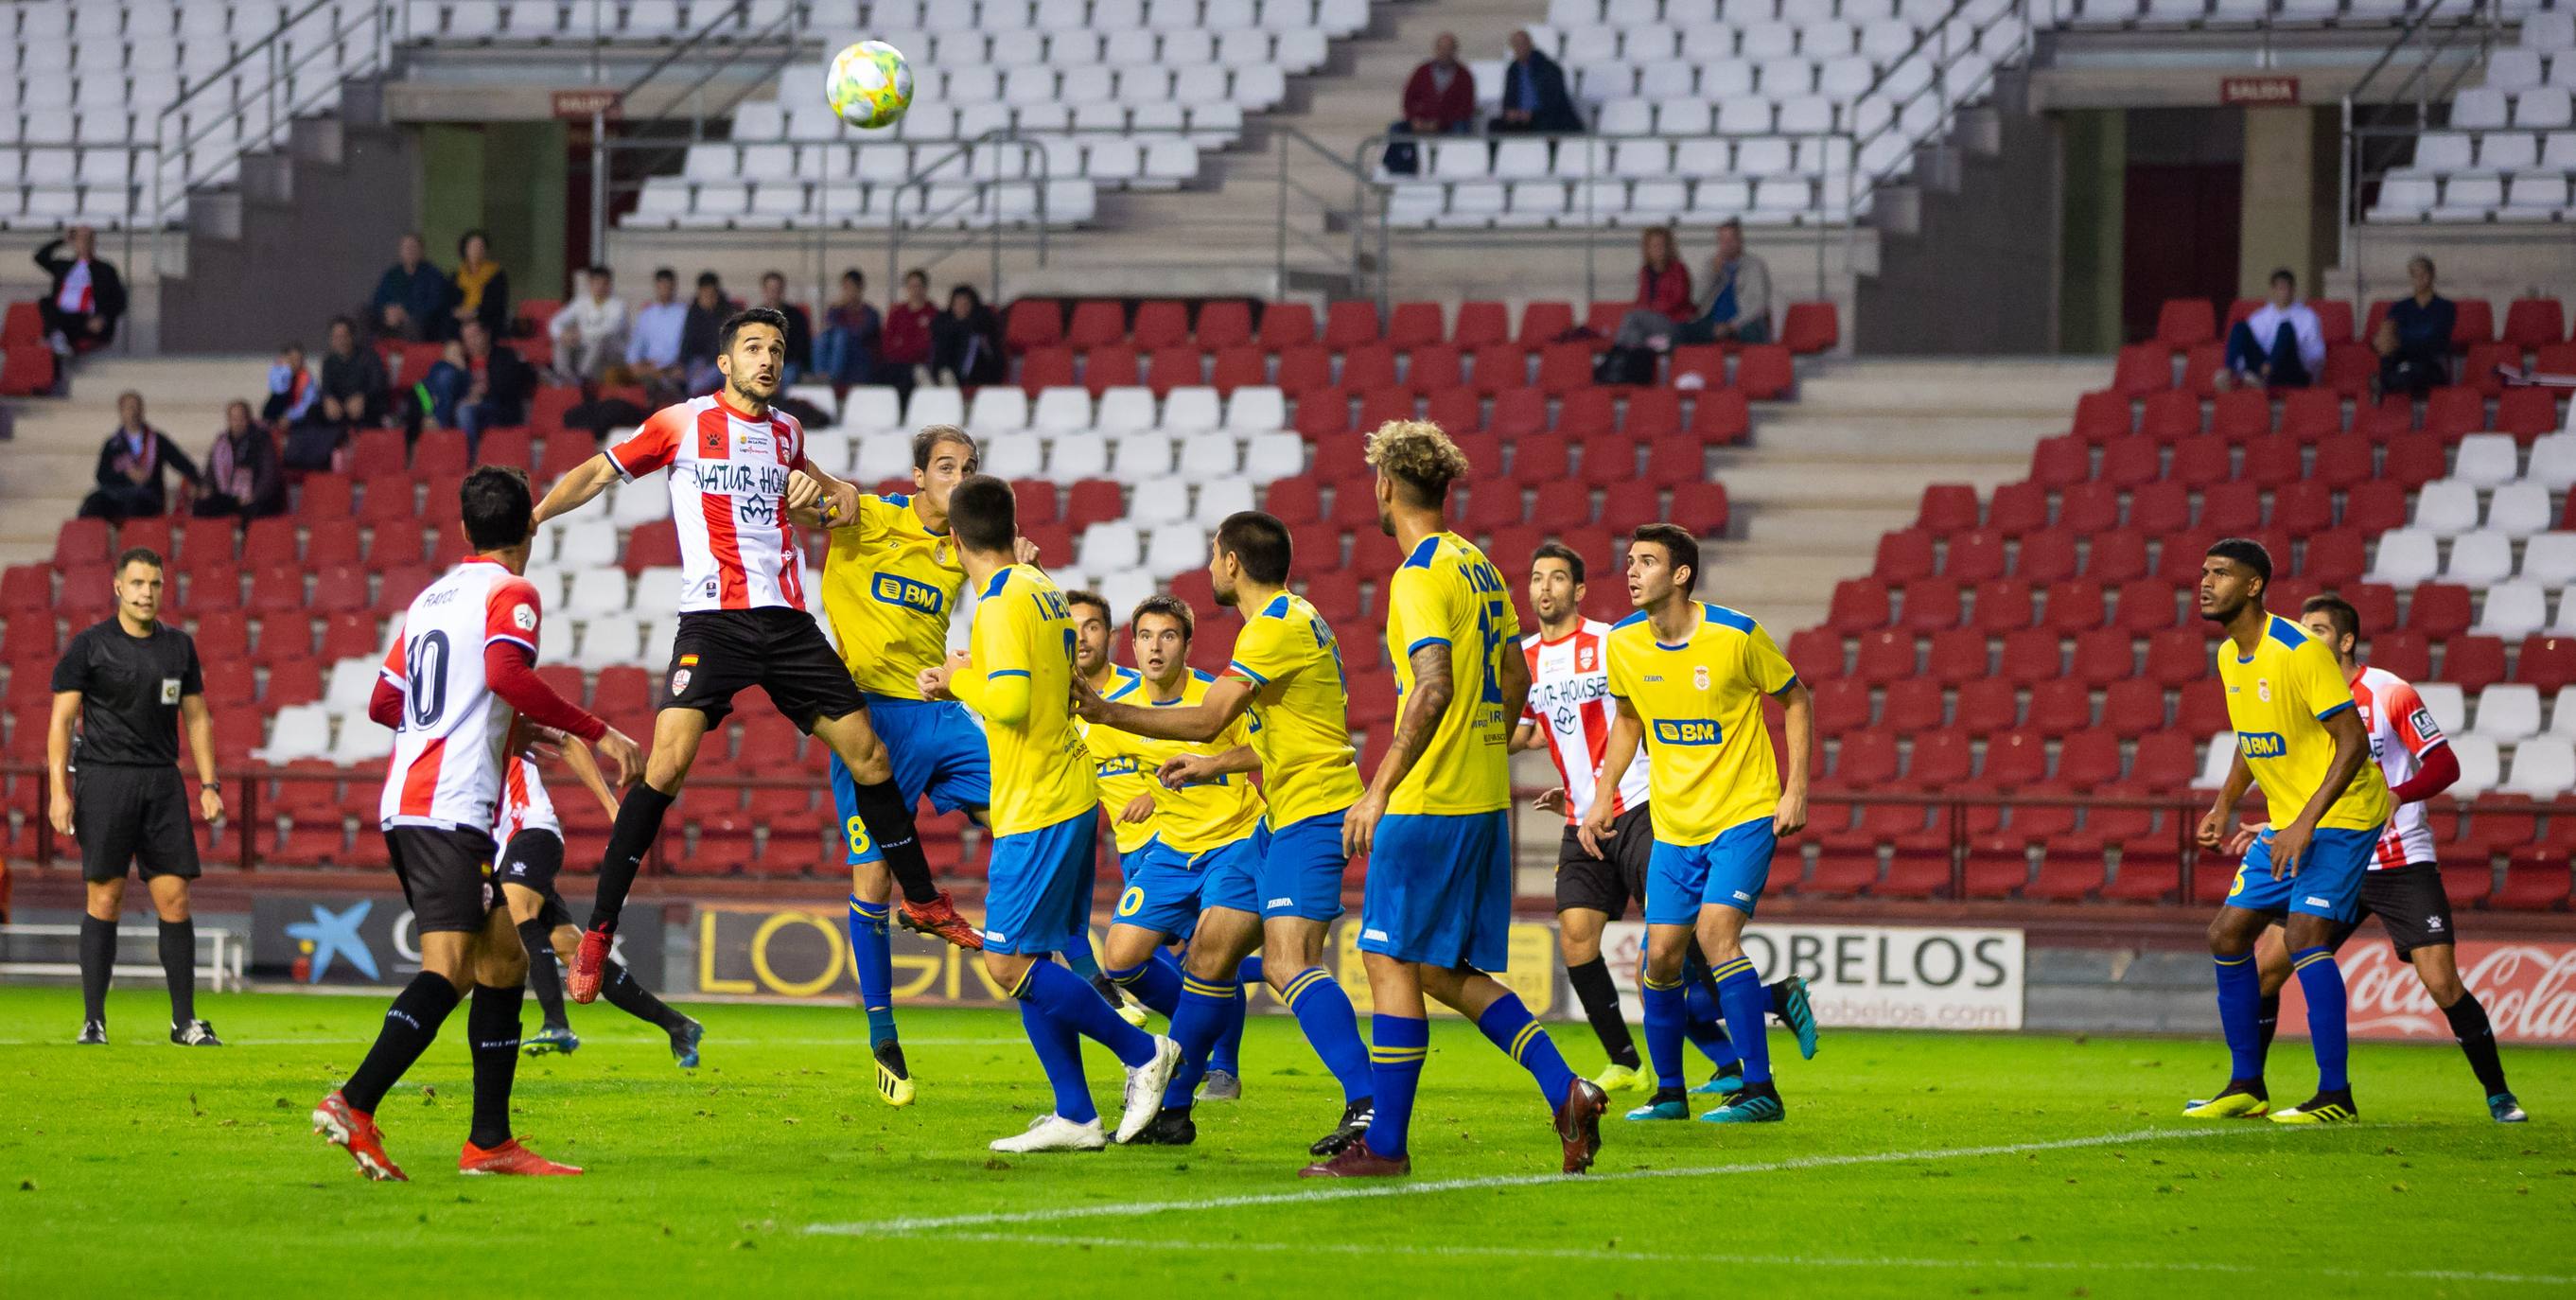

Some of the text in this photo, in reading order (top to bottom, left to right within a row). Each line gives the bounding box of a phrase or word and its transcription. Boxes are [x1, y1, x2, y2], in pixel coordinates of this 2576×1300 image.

[692, 464, 787, 494] NATUR HOU
[904, 584, 938, 611] BM
[1560, 676, 1607, 704] HOUSE
[1681, 724, 1714, 742] BM
[2251, 735, 2279, 754] BM
[848, 816, 869, 853] 8
[1267, 898, 1293, 909] ZEBRA
[1741, 932, 2007, 990] OBELOS
